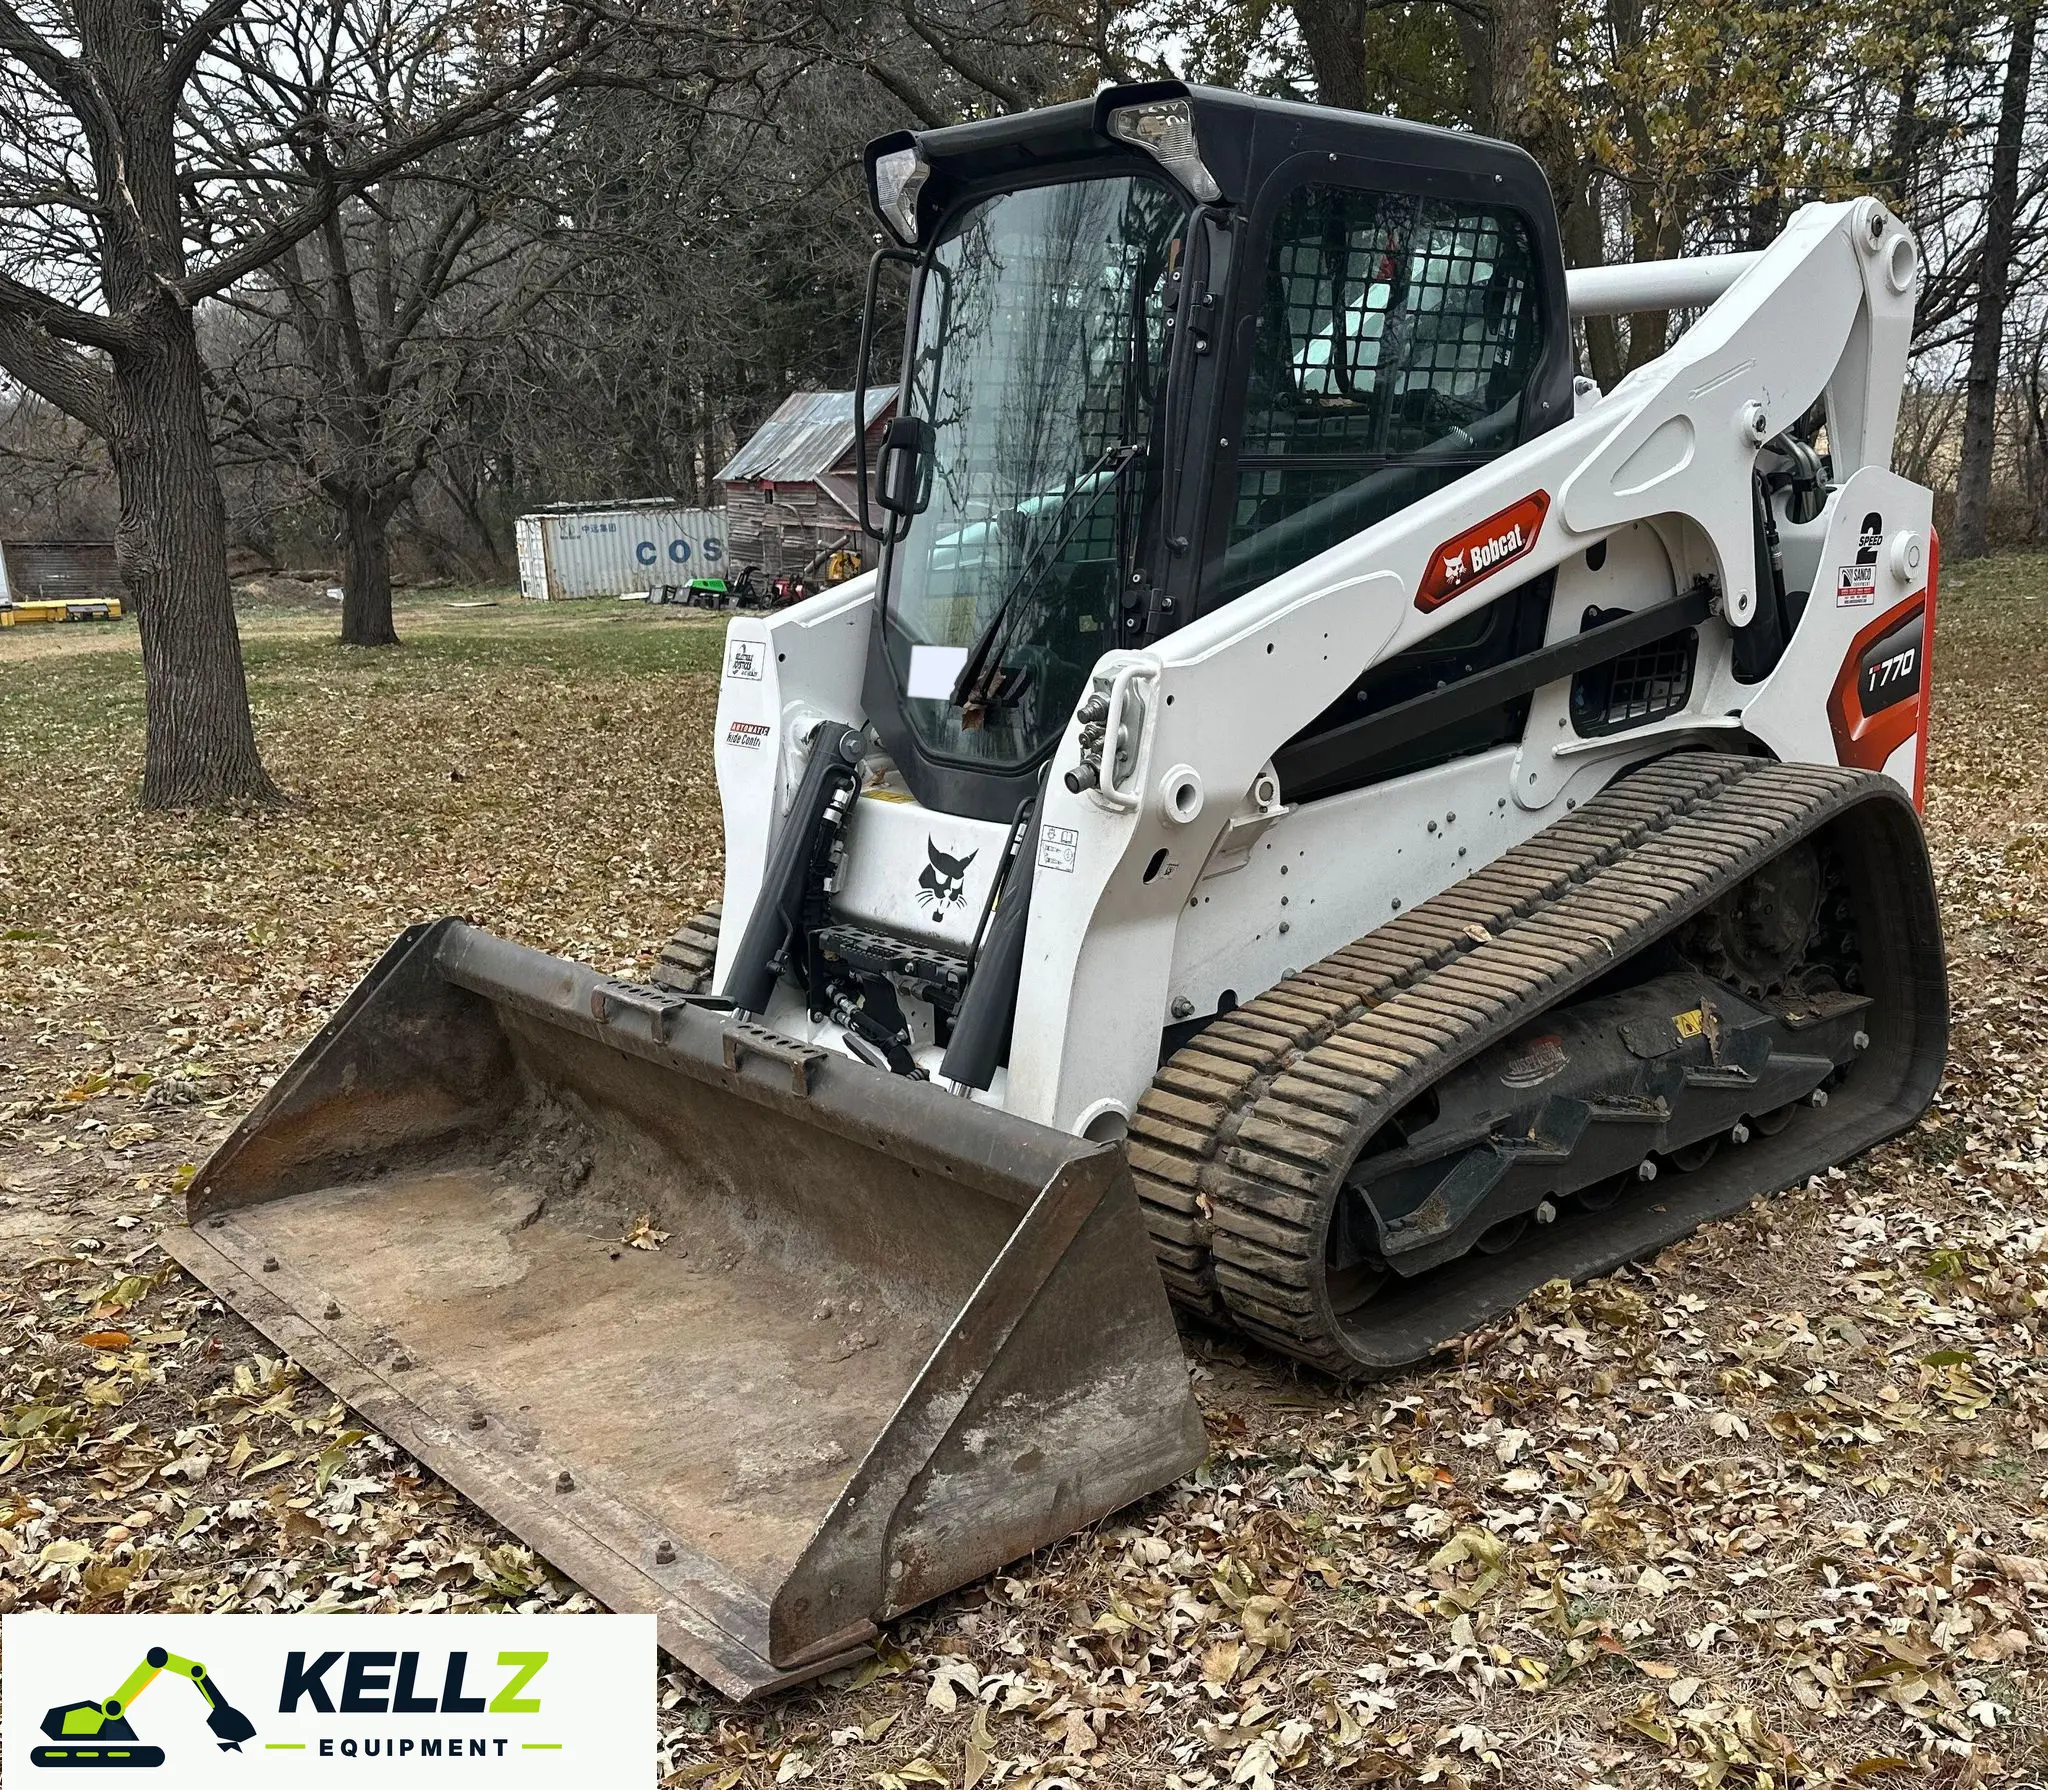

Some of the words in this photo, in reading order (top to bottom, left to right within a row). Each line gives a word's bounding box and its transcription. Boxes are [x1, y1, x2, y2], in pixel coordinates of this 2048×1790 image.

[1470, 523, 1522, 573] Bobcat
[1856, 512, 1882, 565] 2
[1858, 535, 1883, 547] SPEED
[1869, 648, 1915, 692] T770
[731, 723, 770, 736] AUTOMATIC
